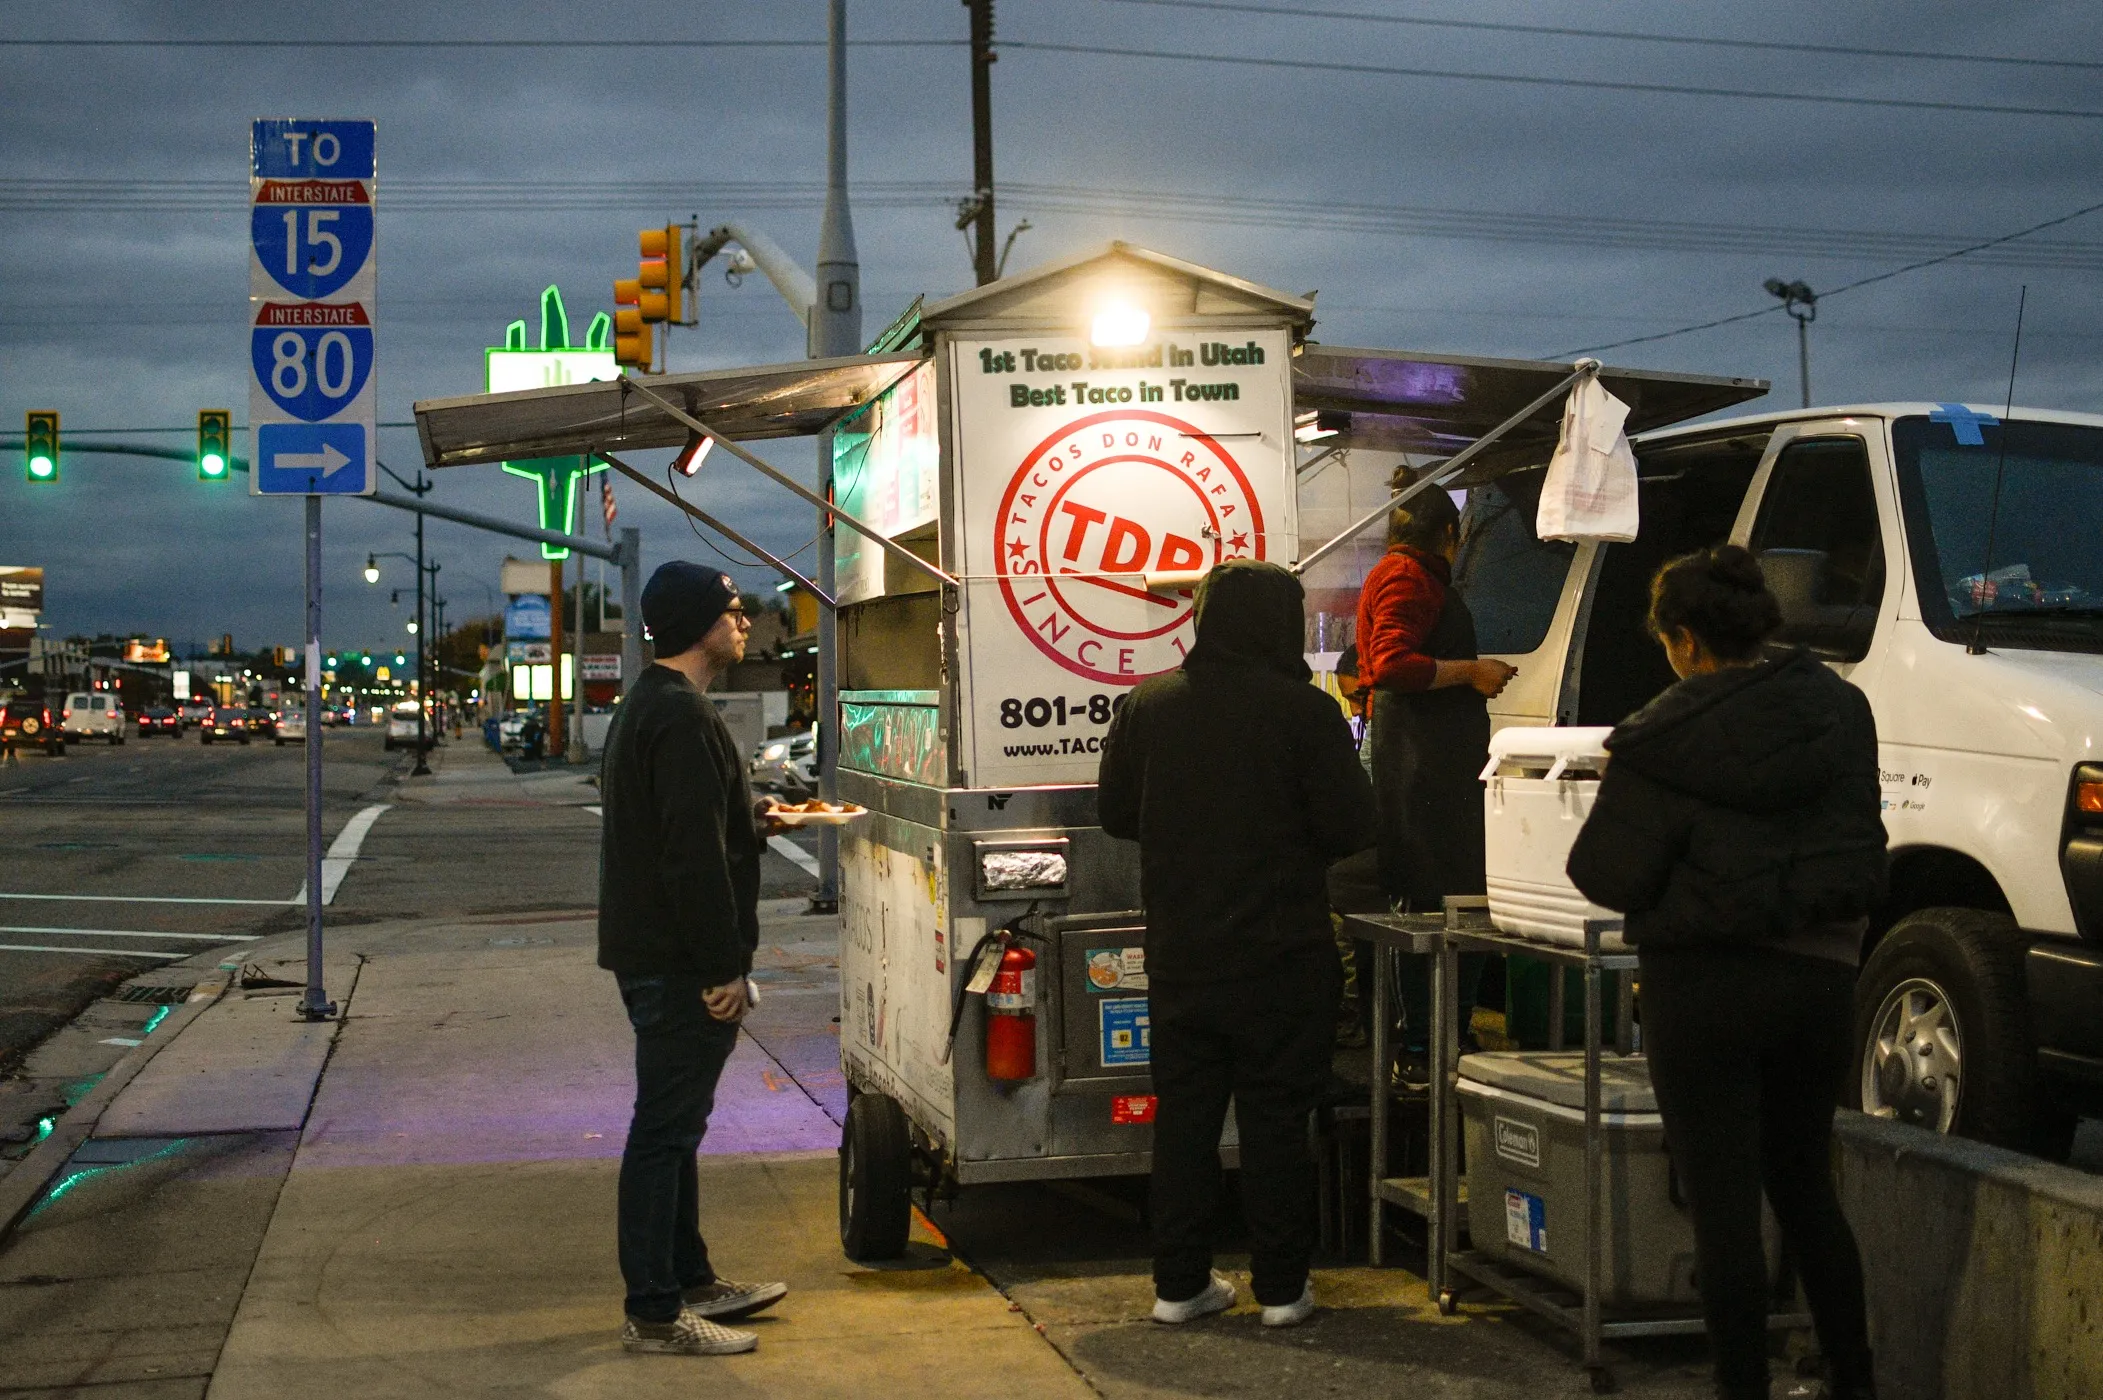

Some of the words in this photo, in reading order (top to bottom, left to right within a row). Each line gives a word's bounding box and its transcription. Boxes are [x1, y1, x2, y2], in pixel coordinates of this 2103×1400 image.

[283, 132, 341, 167] TO
[269, 186, 356, 202] INTERSTATE
[283, 209, 343, 277] 15
[269, 308, 355, 324] INTERSTATE
[271, 331, 354, 398] 80
[979, 347, 1016, 374] 1st
[1020, 347, 1084, 373] Taco
[1169, 344, 1195, 368] in
[1200, 341, 1266, 367] Utah
[1009, 383, 1067, 408] Best
[1071, 382, 1132, 405] Taco
[1139, 381, 1164, 402] in
[1170, 378, 1240, 402] Town
[1011, 444, 1082, 525] TACOS
[1102, 432, 1163, 452] DON
[1180, 450, 1236, 519] RAFA
[1012, 559, 1136, 675] SINCE
[1881, 770, 1905, 784] Square
[1917, 773, 1932, 789] Pay
[1498, 1122, 1529, 1151] Coleman
